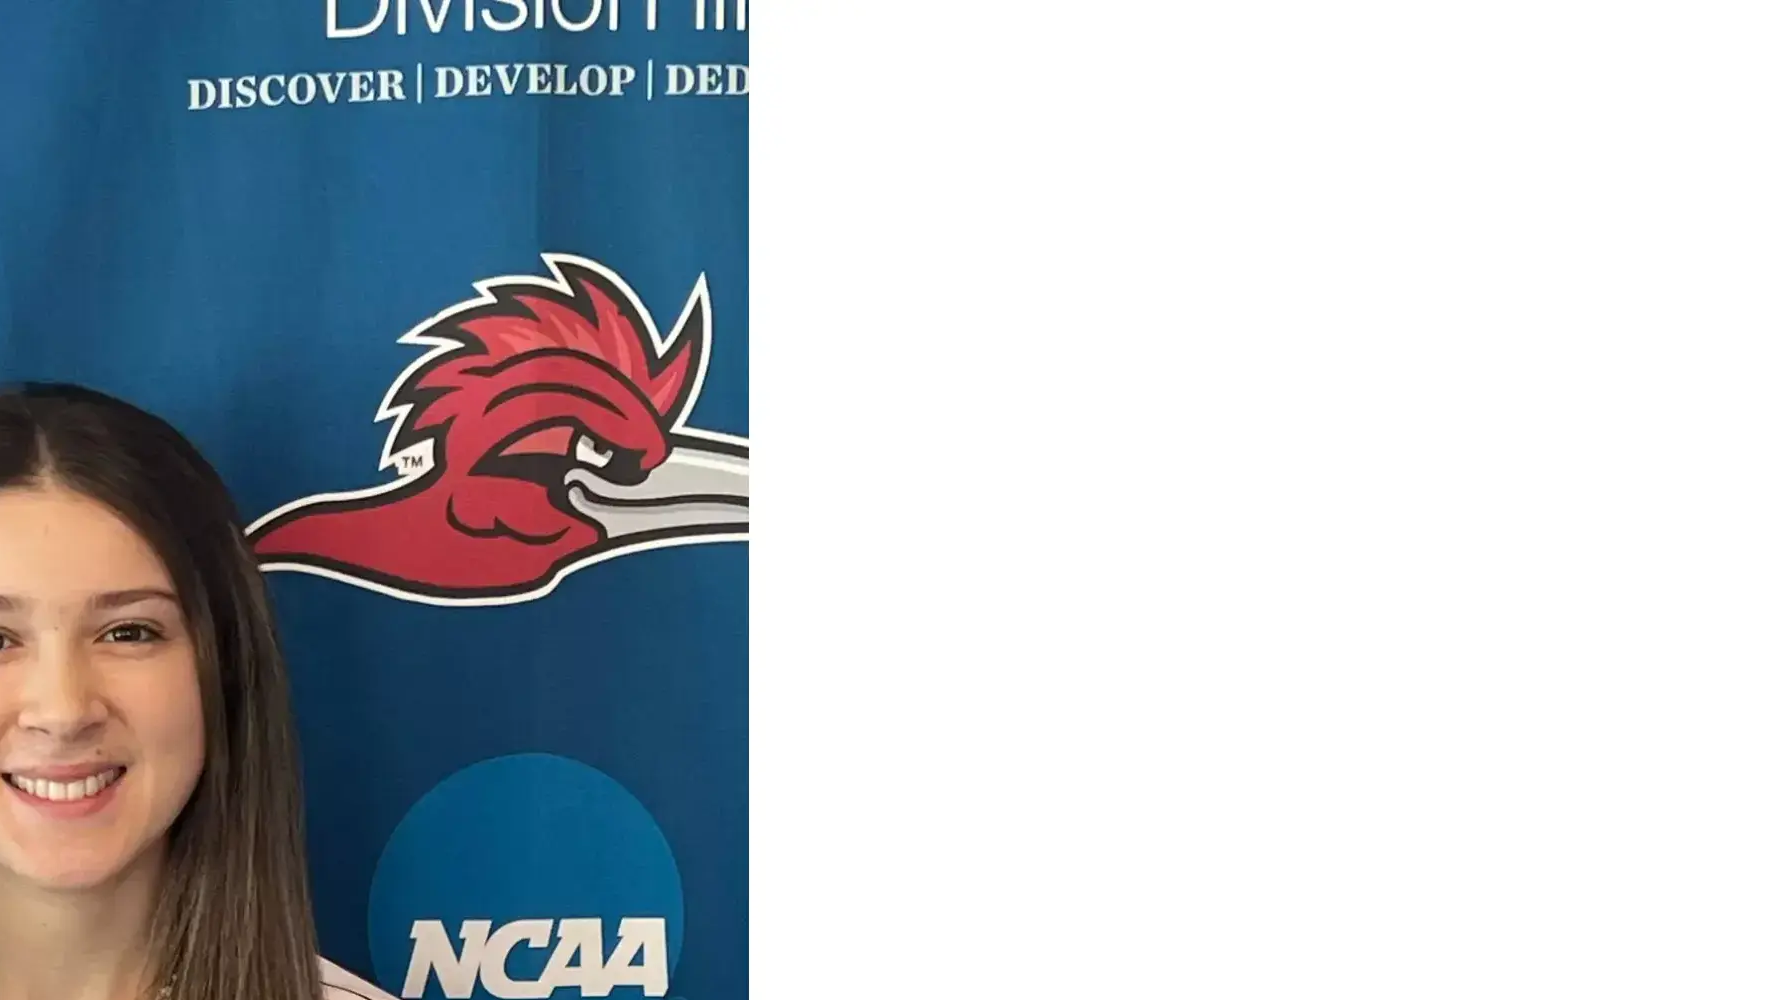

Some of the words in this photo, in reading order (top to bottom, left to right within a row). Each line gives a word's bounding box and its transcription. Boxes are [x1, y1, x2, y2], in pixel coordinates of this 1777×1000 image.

[187, 70, 407, 111] DISCOVER
[434, 63, 637, 99] DEVELOP
[664, 64, 749, 97] DED
[402, 456, 424, 469] TM
[401, 917, 669, 999] NCAA
